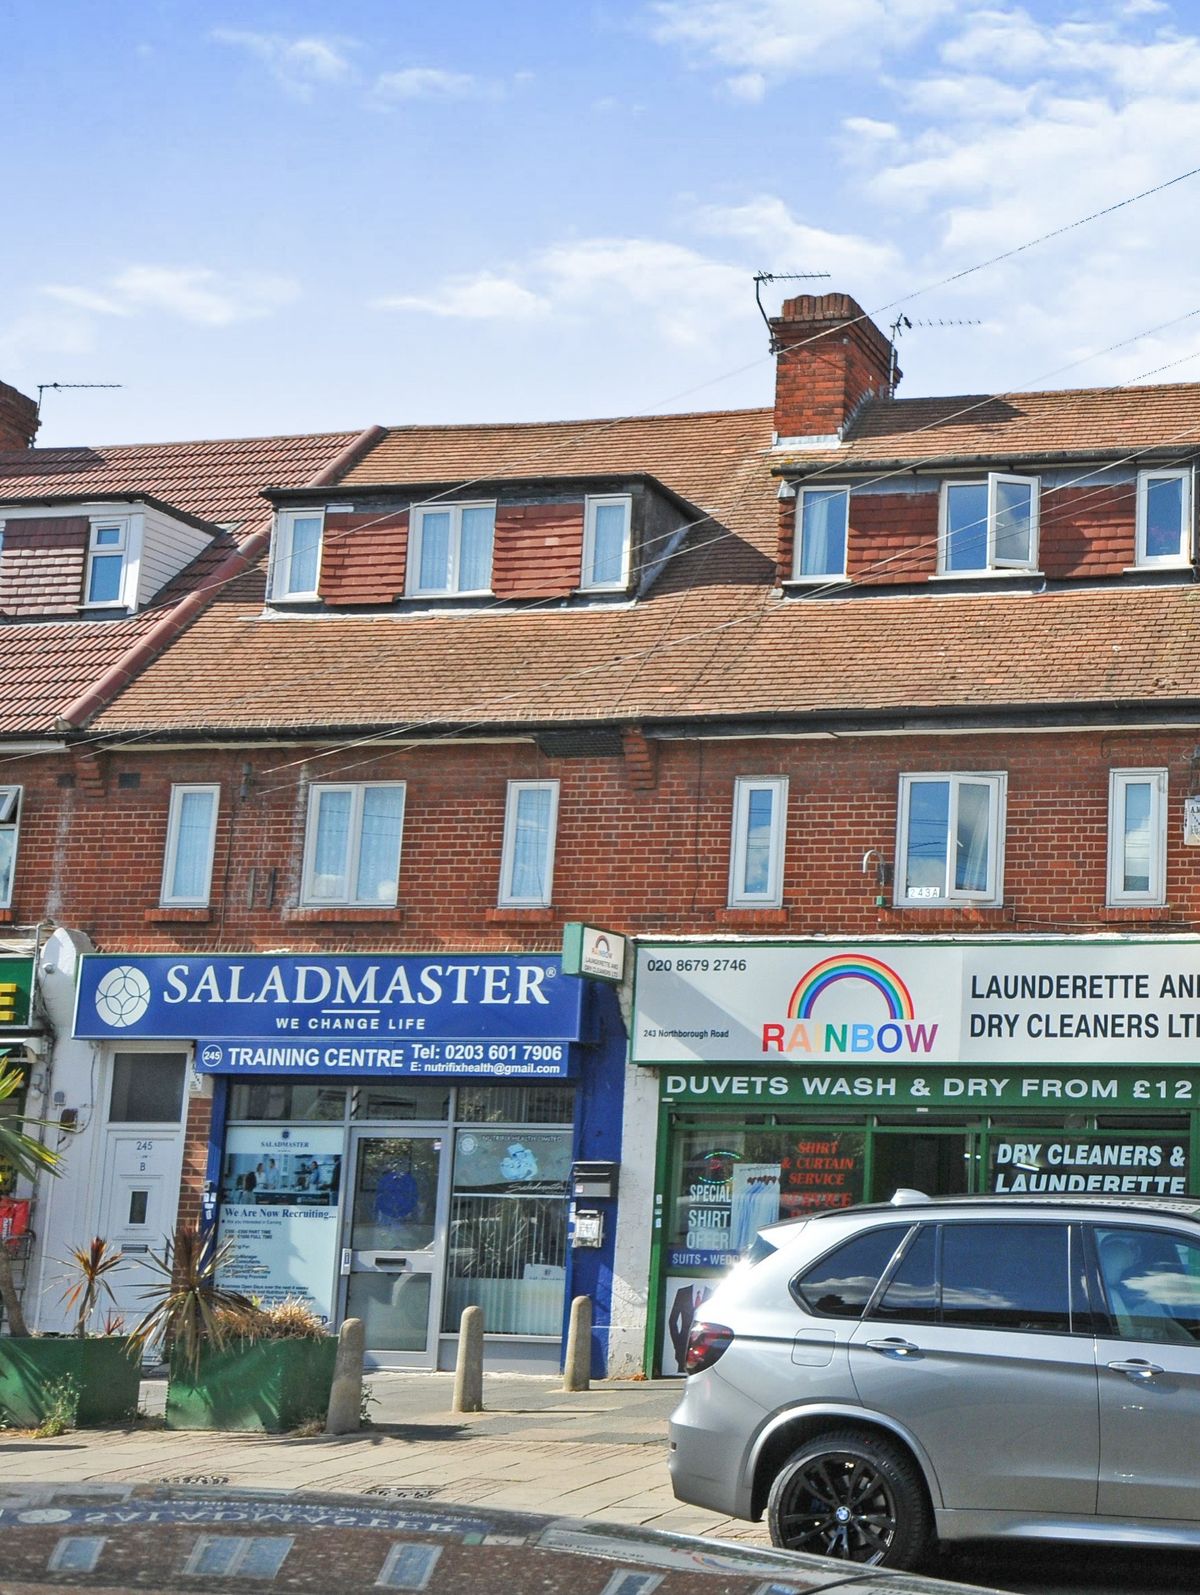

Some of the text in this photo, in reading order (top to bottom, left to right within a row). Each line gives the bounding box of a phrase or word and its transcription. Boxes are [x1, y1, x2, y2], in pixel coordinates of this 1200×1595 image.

[647, 959, 747, 972] 020 8679 2746
[971, 974, 1149, 999] LAUNDERETTE
[275, 1018, 426, 1030] WE CHANGE LIFE
[970, 1013, 1020, 1038] DRY
[1026, 1013, 1159, 1039] CLEANERS
[643, 1028, 730, 1040] 243 Northborough Road
[762, 1023, 939, 1053] RAINBOW
[204, 1047, 404, 1068] 245 TRAINING CENTRE
[411, 1044, 563, 1061] Tel: 0203 601 7906
[410, 1062, 560, 1076] E: nutrifixhealth@gmail.com
[666, 1075, 1192, 1099] DUVETS WASH & DRY FROM £12
[136, 1141, 153, 1151] 245
[797, 1142, 839, 1154] SHIRT
[780, 1157, 854, 1170] & CURTAIN
[997, 1143, 1186, 1168] DRY CLEANERS &
[788, 1173, 845, 1186] SERVICE
[995, 1173, 1187, 1195] LAUNDERETTE
[689, 1184, 732, 1203] SPECIAL
[225, 1208, 239, 1217] We
[241, 1208, 257, 1218] Are
[260, 1209, 279, 1218] Now
[688, 1210, 730, 1228] SHIRT
[686, 1231, 729, 1251] OFFER
[672, 1253, 701, 1265] SUITS
